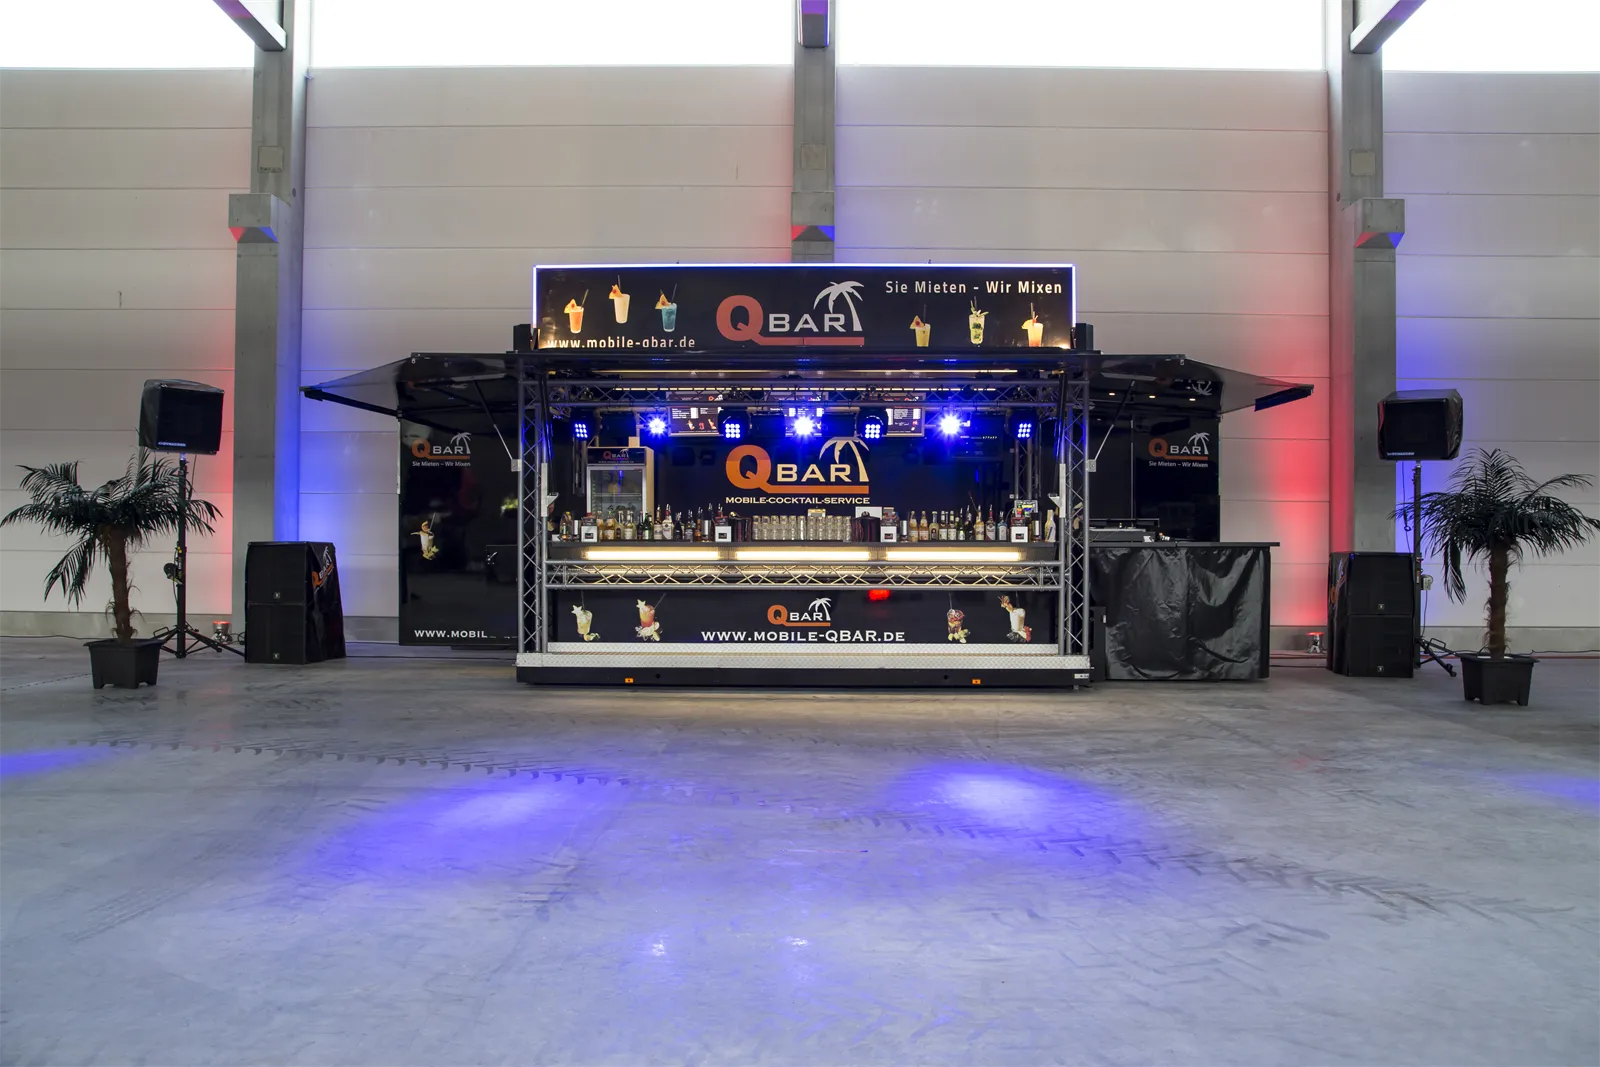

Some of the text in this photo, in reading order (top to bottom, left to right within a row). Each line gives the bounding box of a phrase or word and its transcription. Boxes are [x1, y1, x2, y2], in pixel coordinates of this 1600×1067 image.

[885, 280, 908, 294] Sie
[914, 280, 967, 294] Mieten
[986, 280, 1012, 294] Wir
[1018, 280, 1062, 294] Mixen
[725, 496, 871, 504] MOBILE-COCKTAIL-SERVICE
[414, 629, 495, 639] WWW.MOBIL
[701, 630, 905, 643] WWW.MOBILE-QBAR.DE
